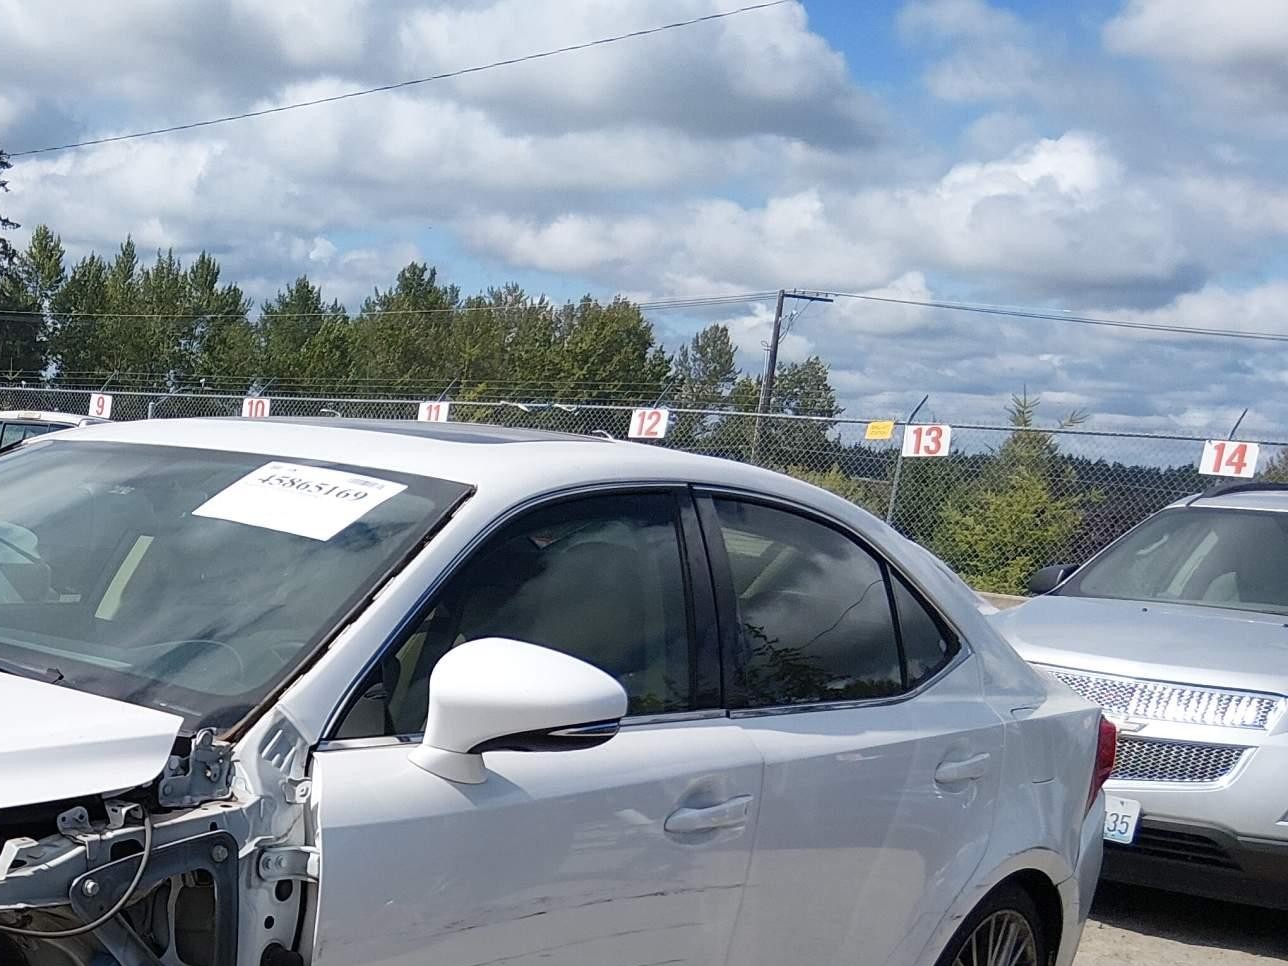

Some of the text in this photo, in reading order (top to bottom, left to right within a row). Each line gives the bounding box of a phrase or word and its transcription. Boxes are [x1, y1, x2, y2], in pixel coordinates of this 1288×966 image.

[95, 396, 105, 415] 9
[248, 399, 265, 417] 10
[426, 404, 441, 421] 11
[638, 410, 662, 436] 12
[913, 426, 943, 455] 13
[1212, 442, 1248, 475] 14
[258, 474, 369, 502] 45865169
[1105, 811, 1132, 835] 35
